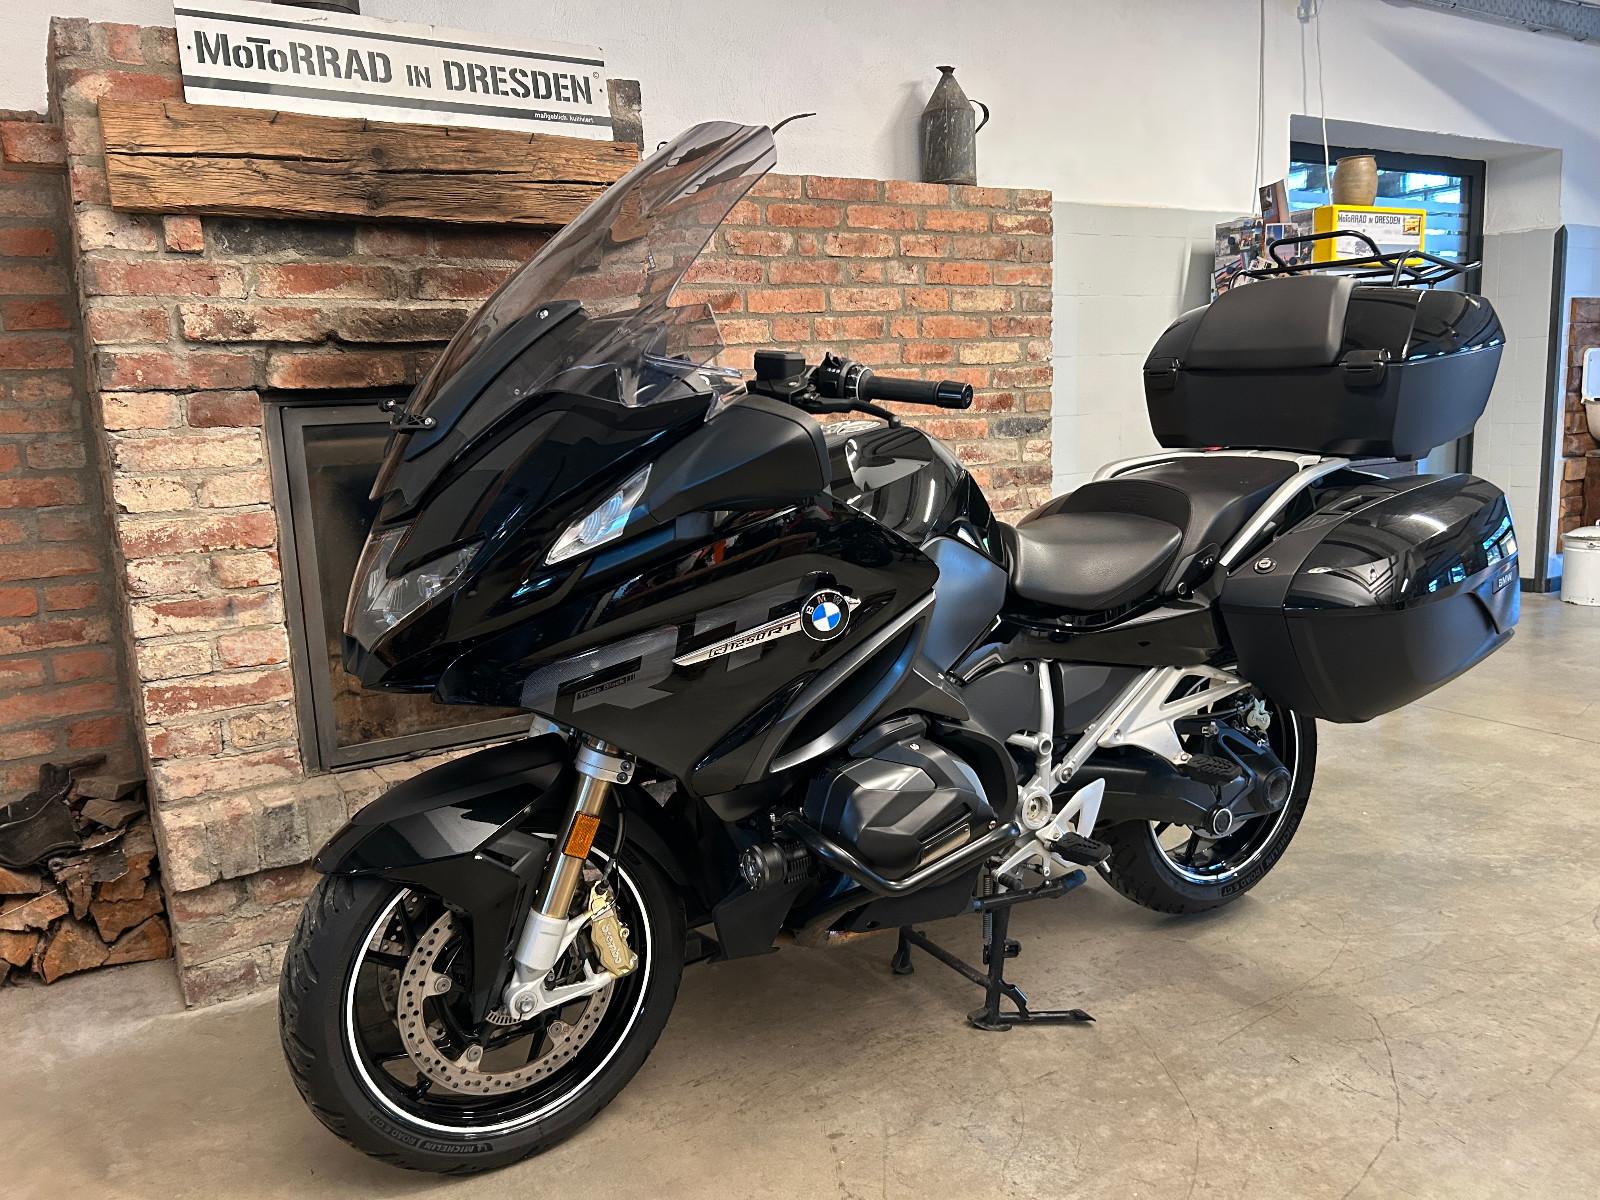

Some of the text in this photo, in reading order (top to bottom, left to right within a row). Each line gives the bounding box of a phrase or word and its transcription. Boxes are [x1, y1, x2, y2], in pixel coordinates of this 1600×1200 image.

[406, 64, 432, 88] IN
[443, 60, 593, 104] DRESDEN
[1498, 571, 1513, 588] BMW
[804, 594, 843, 615] BMW
[423, 1142, 475, 1153] MICHELIN
